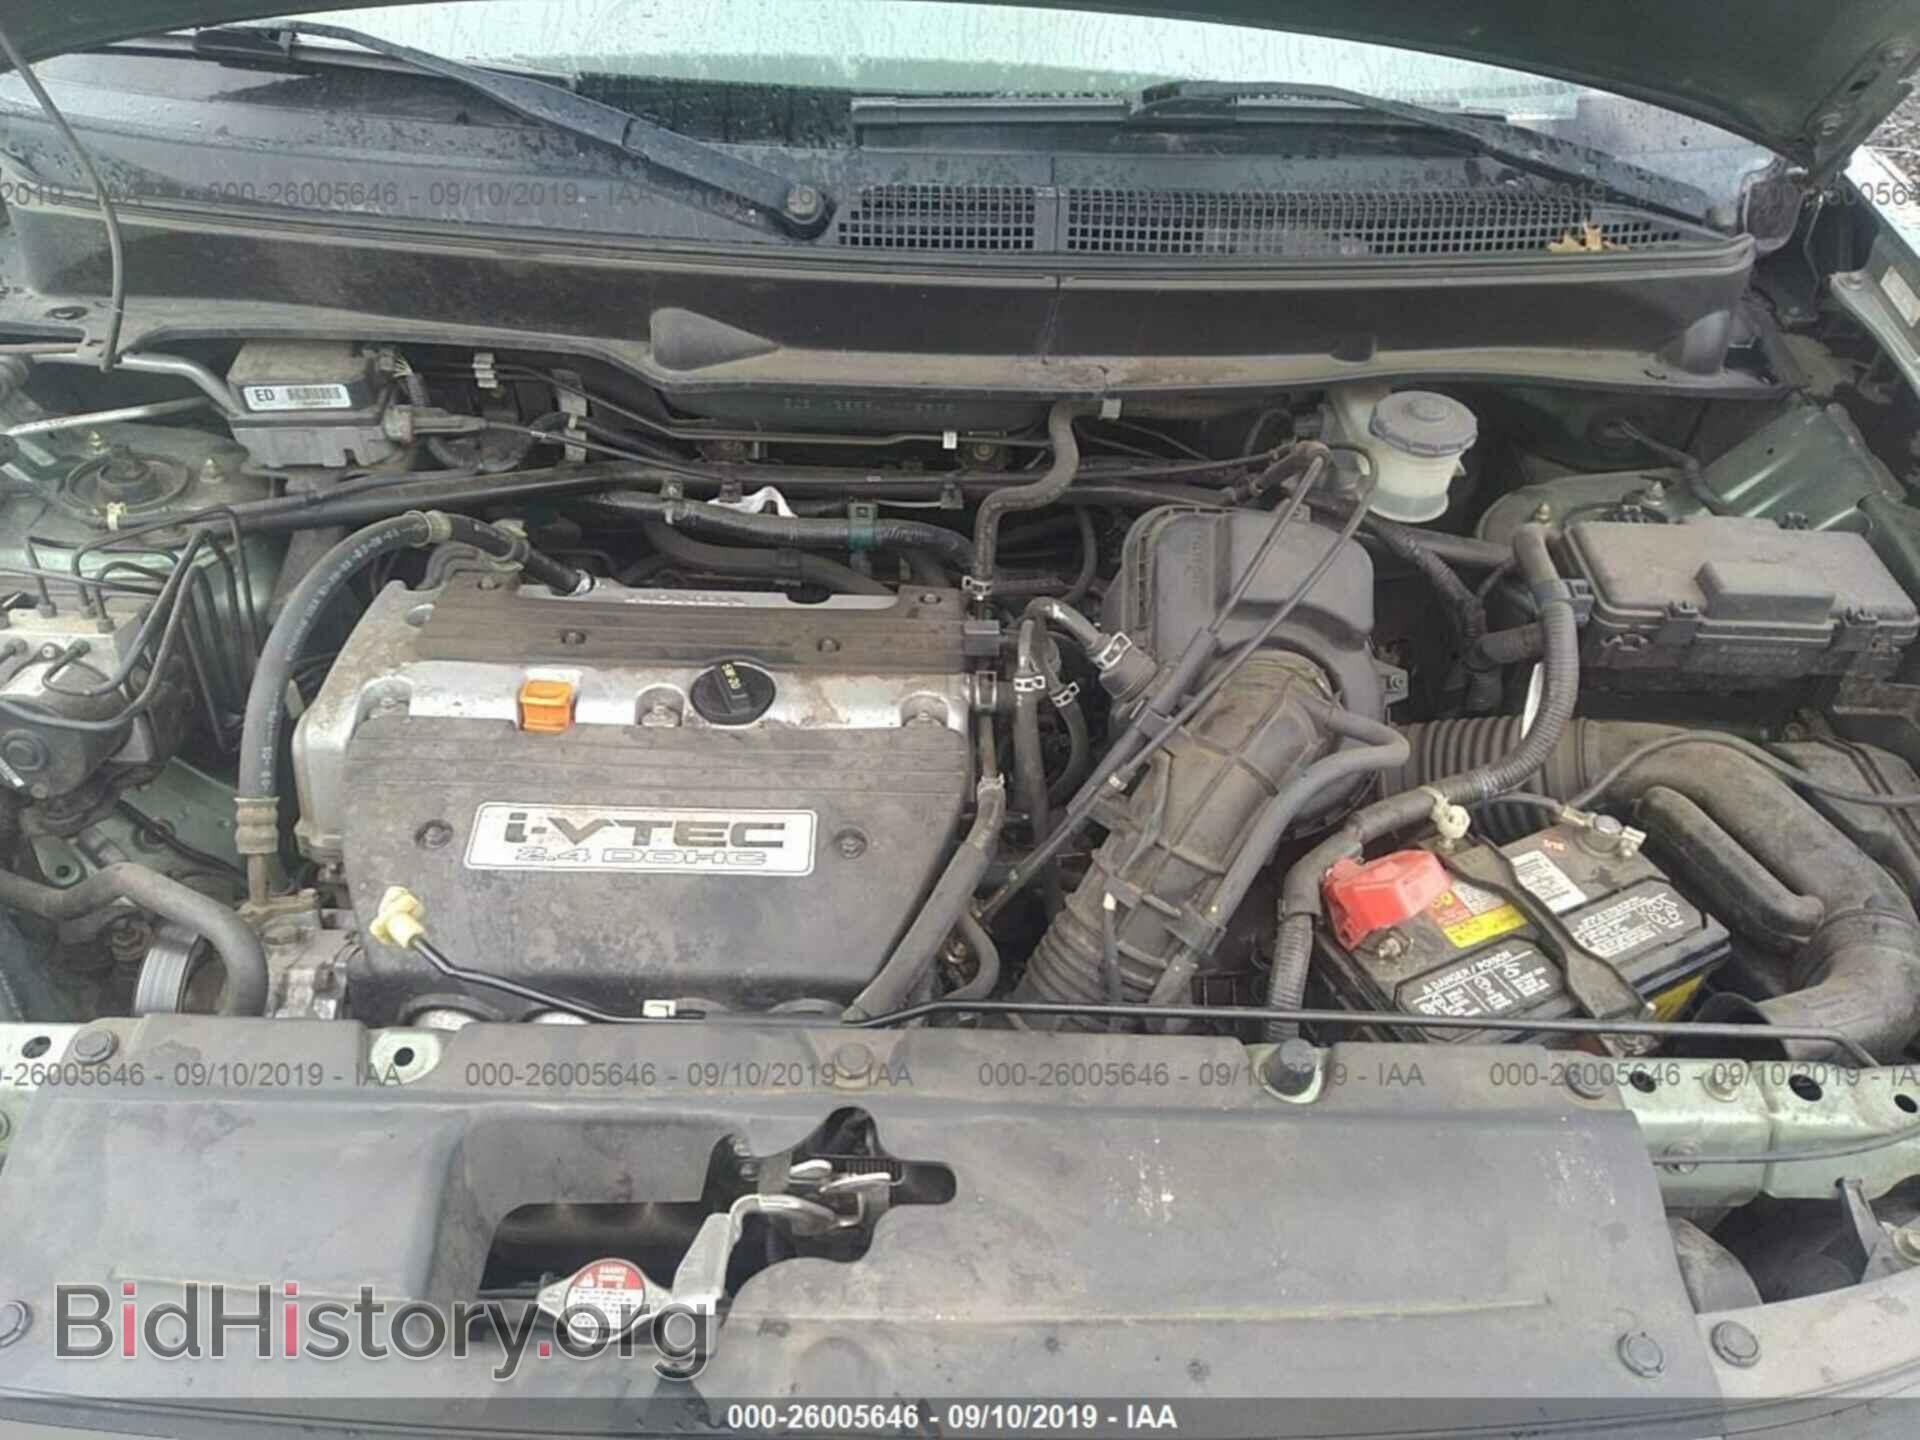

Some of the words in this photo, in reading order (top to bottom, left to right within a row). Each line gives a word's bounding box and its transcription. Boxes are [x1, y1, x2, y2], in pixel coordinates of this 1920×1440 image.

[504, 812, 786, 848] i-VTEC
[515, 847, 592, 864] 2.4
[601, 848, 768, 866] DOHC
